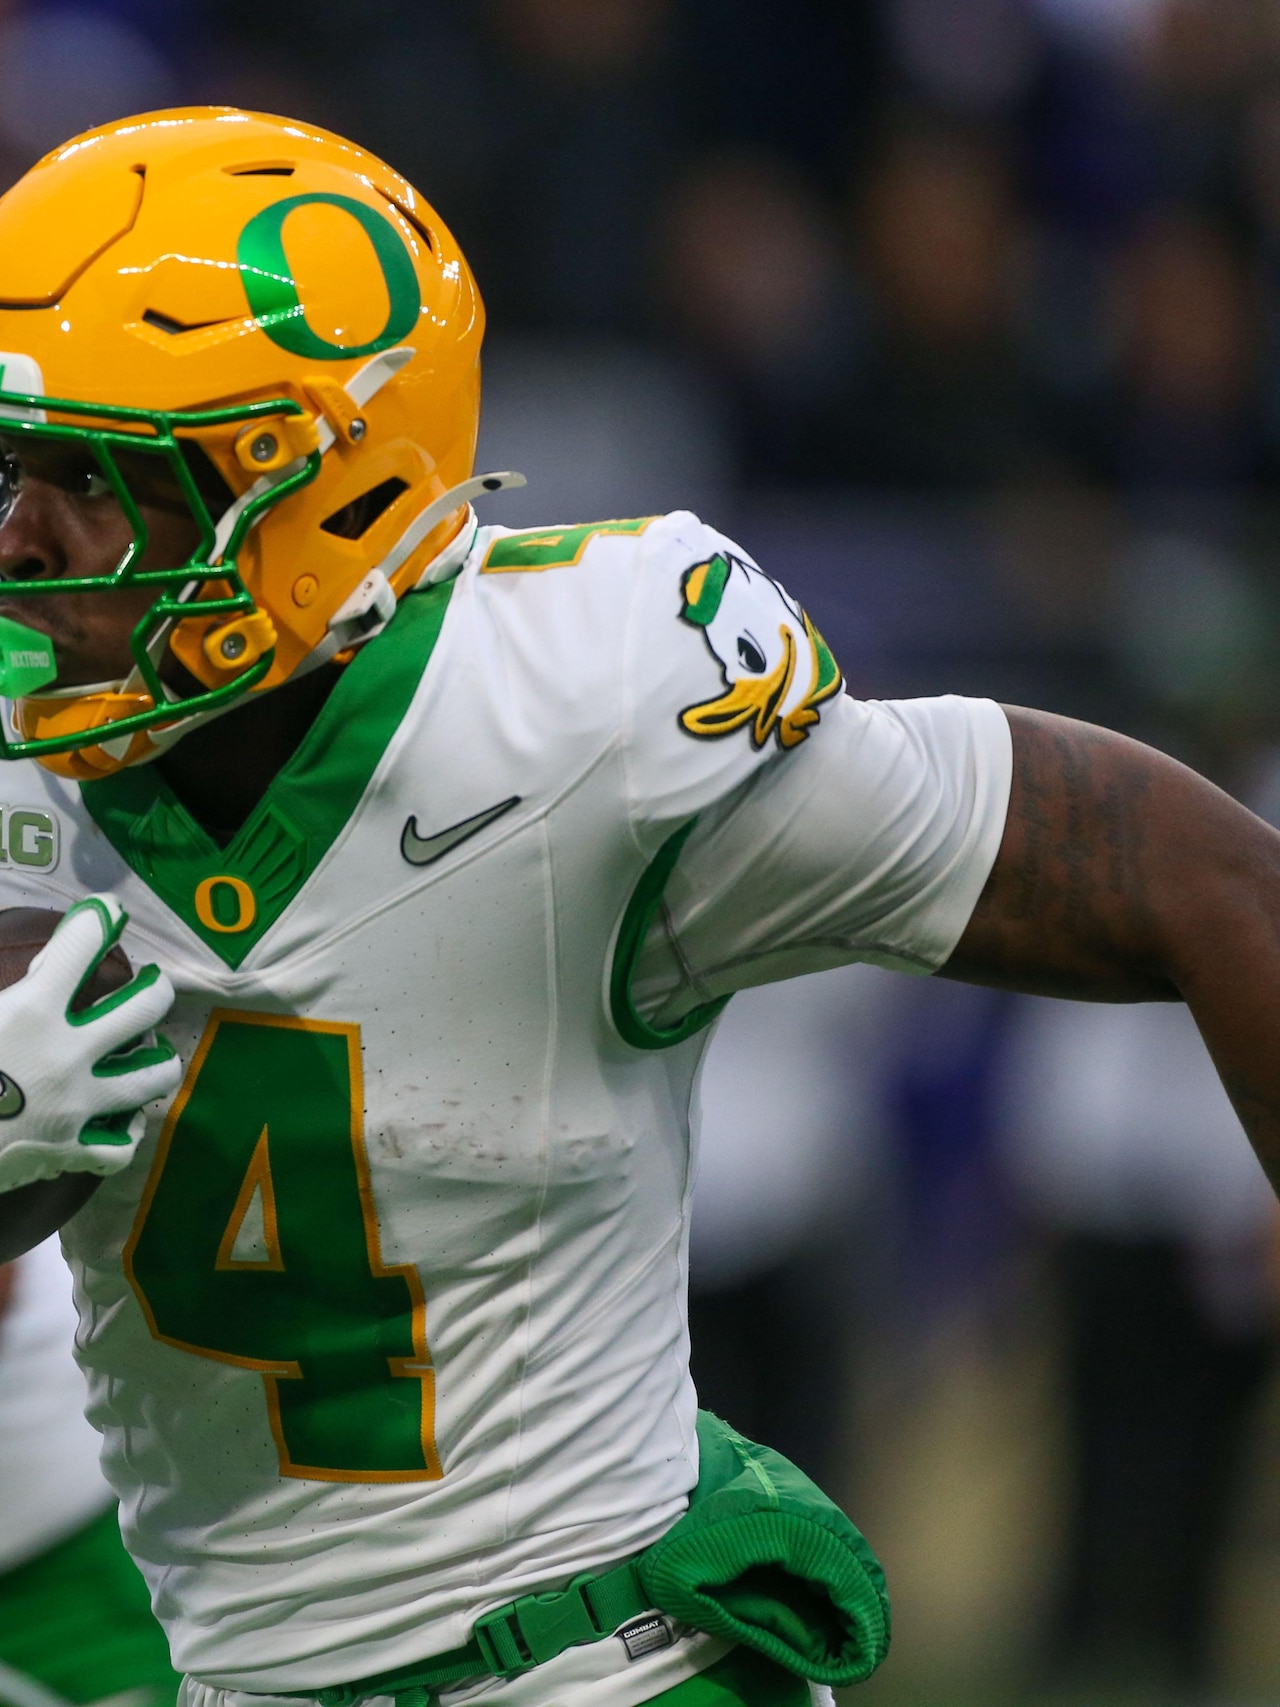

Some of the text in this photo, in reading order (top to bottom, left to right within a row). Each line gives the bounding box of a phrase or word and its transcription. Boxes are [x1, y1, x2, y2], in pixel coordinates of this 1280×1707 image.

[236, 192, 421, 361] O
[194, 876, 256, 932] O
[122, 1007, 444, 1483] 4
[623, 1619, 659, 1639] COMBAT
